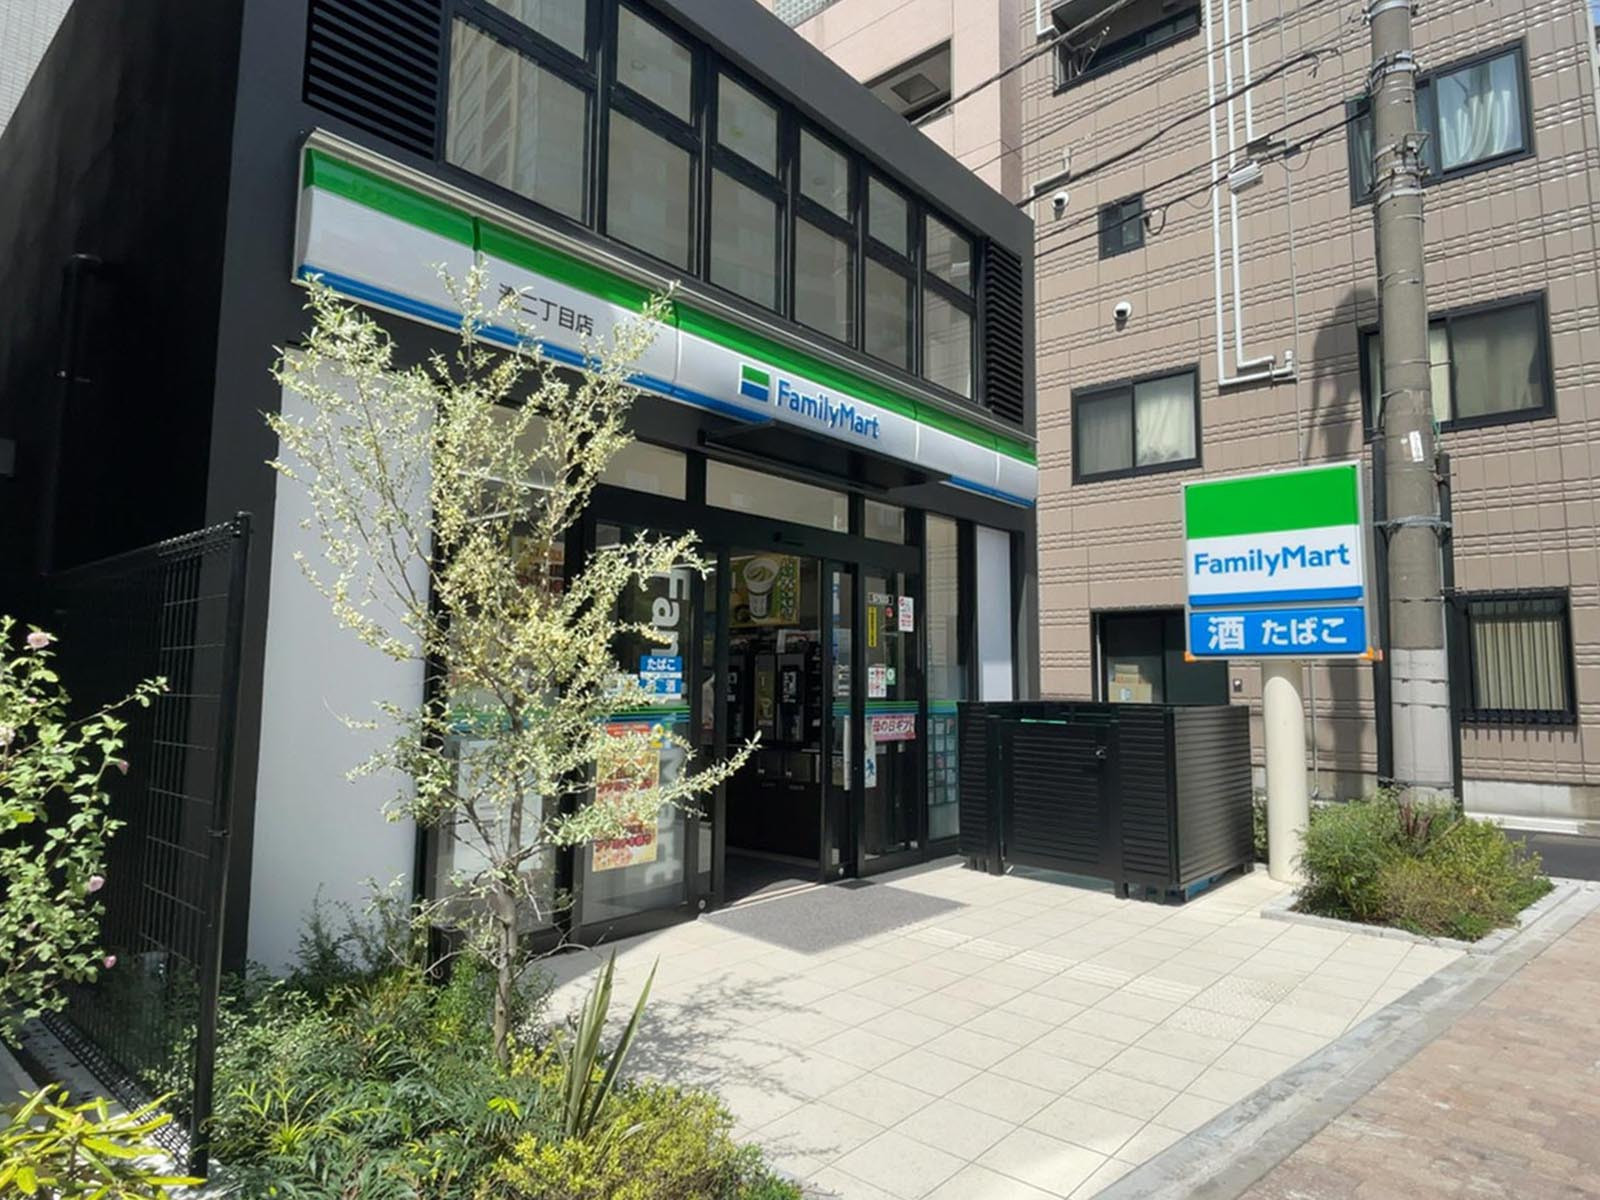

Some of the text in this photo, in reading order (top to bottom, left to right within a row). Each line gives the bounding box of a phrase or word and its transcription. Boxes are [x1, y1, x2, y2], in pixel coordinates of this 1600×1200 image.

[776, 378, 881, 439] FamilyMart
[1193, 543, 1351, 577] FamilyMart
[1207, 615, 1348, 652] 酒 たばこ
[646, 657, 676, 671] たばこ
